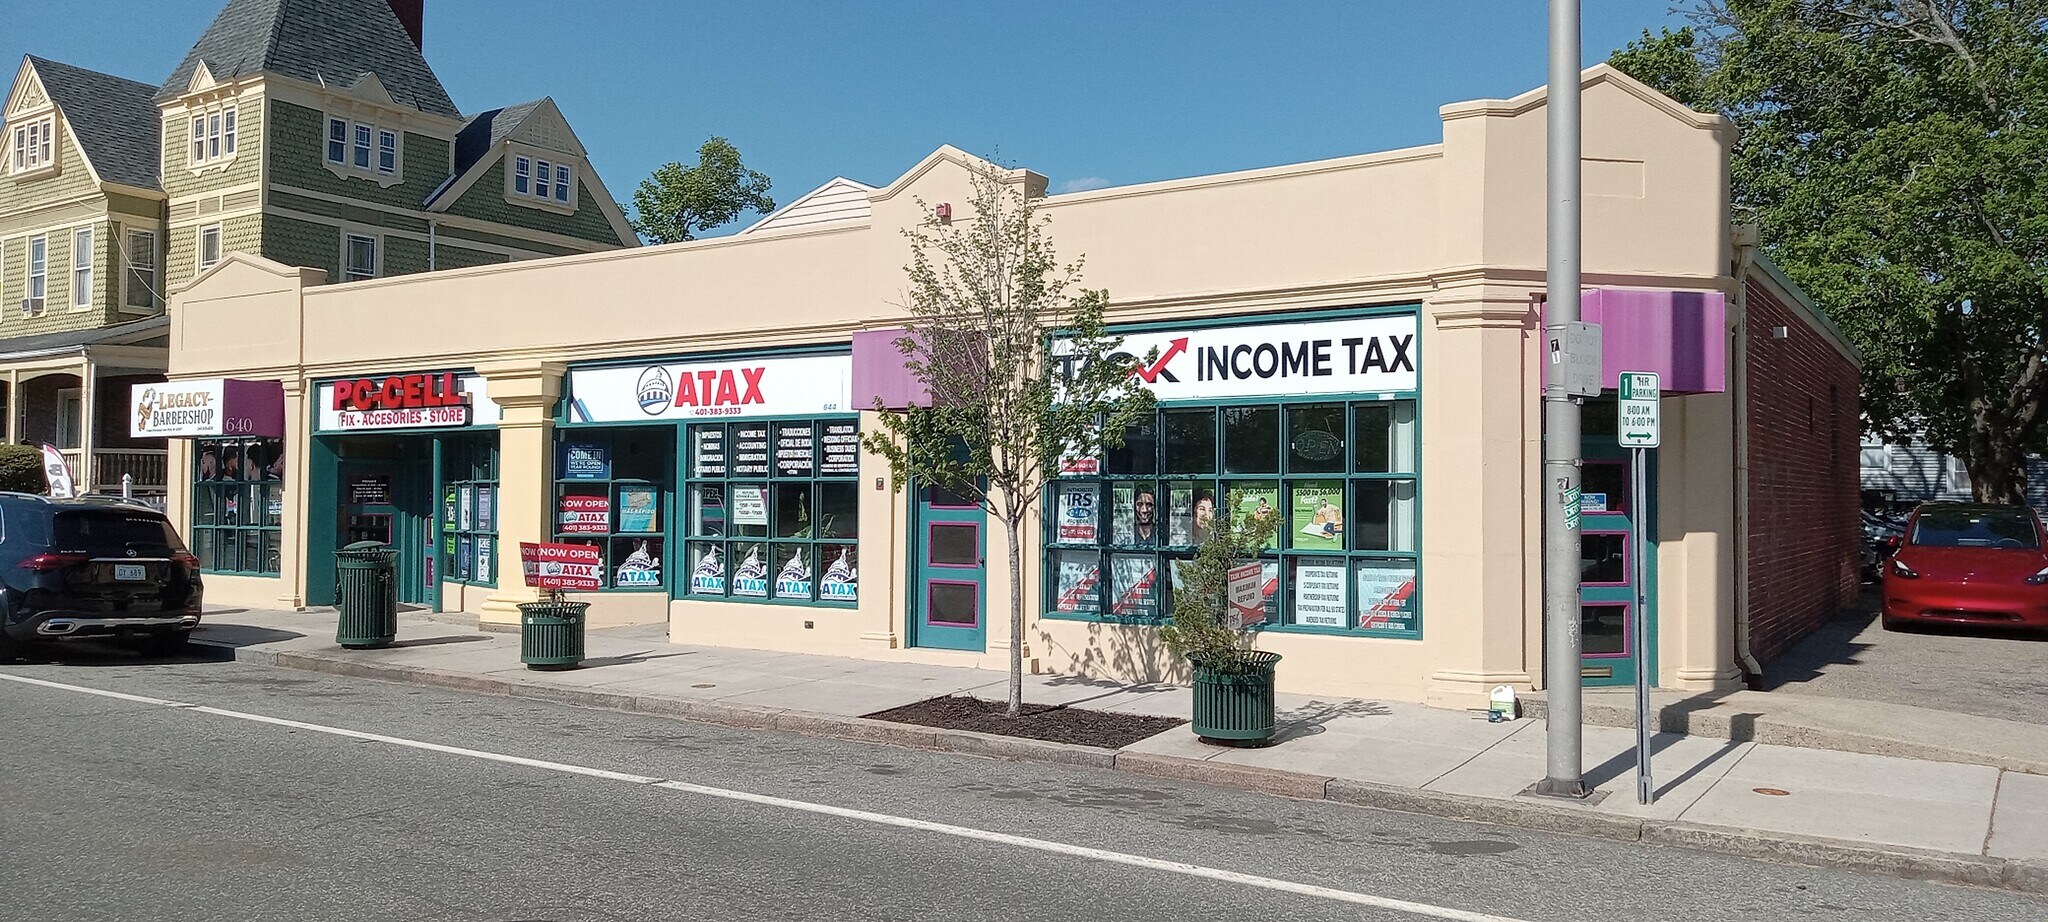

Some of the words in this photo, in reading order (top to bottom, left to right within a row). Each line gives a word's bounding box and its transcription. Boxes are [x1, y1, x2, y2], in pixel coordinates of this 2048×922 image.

[1197, 339, 1332, 382] INCOME
[1342, 334, 1414, 374] TAX
[1638, 376, 1650, 386] HR
[333, 372, 462, 410] PC-CELL
[674, 367, 766, 408] ATAX
[1624, 378, 1628, 396] 1
[1632, 388, 1656, 398] PARKING
[159, 391, 211, 410] LEGACY
[694, 407, 742, 416] 401-383-9333
[1641, 406, 1650, 415] AM
[153, 409, 214, 427] BARBERSHOP
[341, 414, 355, 427] FIX
[362, 412, 422, 426] ACCESORIES
[430, 409, 463, 423] STORE
[1622, 417, 1630, 426] TO
[1646, 418, 1656, 427] PM
[226, 417, 252, 432] 640
[570, 450, 592, 459] COME
[1320, 488, 1341, 496] $6,000
[585, 500, 609, 508] OPEN
[1067, 493, 1092, 506] IRS
[578, 514, 605, 522] ATAX
[540, 548, 567, 557] NOW
[570, 550, 598, 559] OPEN
[562, 565, 593, 576] ATAX
[544, 578, 561, 586] (401)
[562, 578, 595, 587] 383-9333
[619, 572, 656, 582] ATAX
[693, 577, 723, 588] ATAX
[735, 578, 765, 591] ATAX
[778, 581, 809, 593] ATAX
[822, 582, 855, 595] ATAX
[1238, 592, 1255, 603] REFUND
